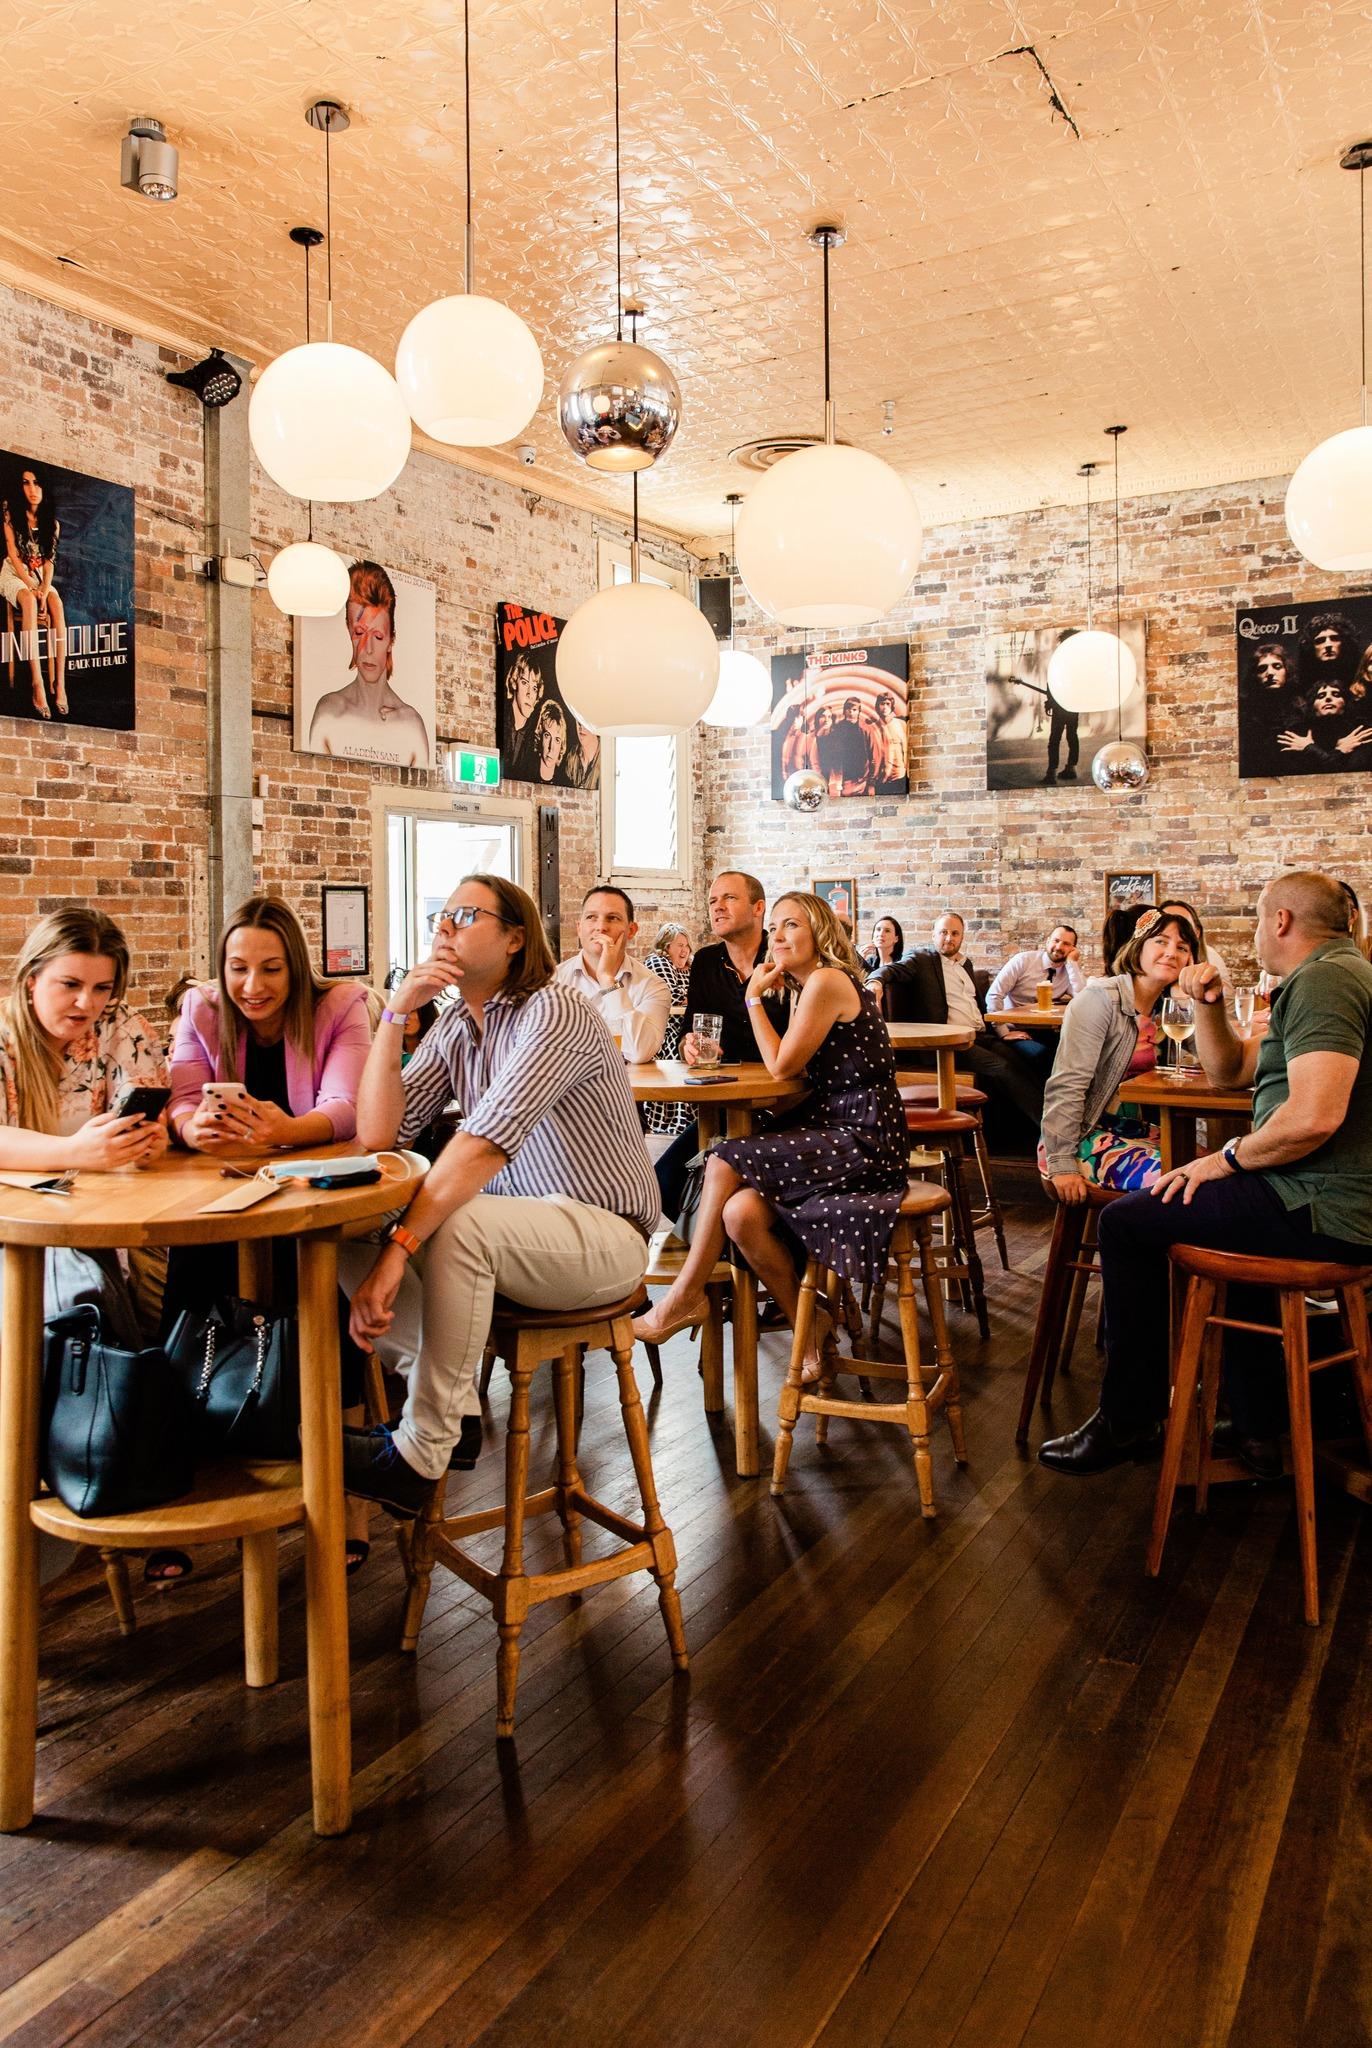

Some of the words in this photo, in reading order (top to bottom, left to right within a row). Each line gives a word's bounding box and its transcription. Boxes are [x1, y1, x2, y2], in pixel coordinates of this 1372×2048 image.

[504, 604, 523, 620] THE
[503, 613, 558, 651] POLICE
[1239, 617, 1280, 640] Queen
[1281, 614, 1299, 635] II
[68, 658, 91, 671] BACK
[91, 657, 102, 668] TO
[102, 654, 128, 668] BLACK
[807, 655, 830, 666] THE
[831, 651, 866, 664] KINKS
[545, 814, 555, 831] M
[1109, 879, 1152, 894] Cocktails
